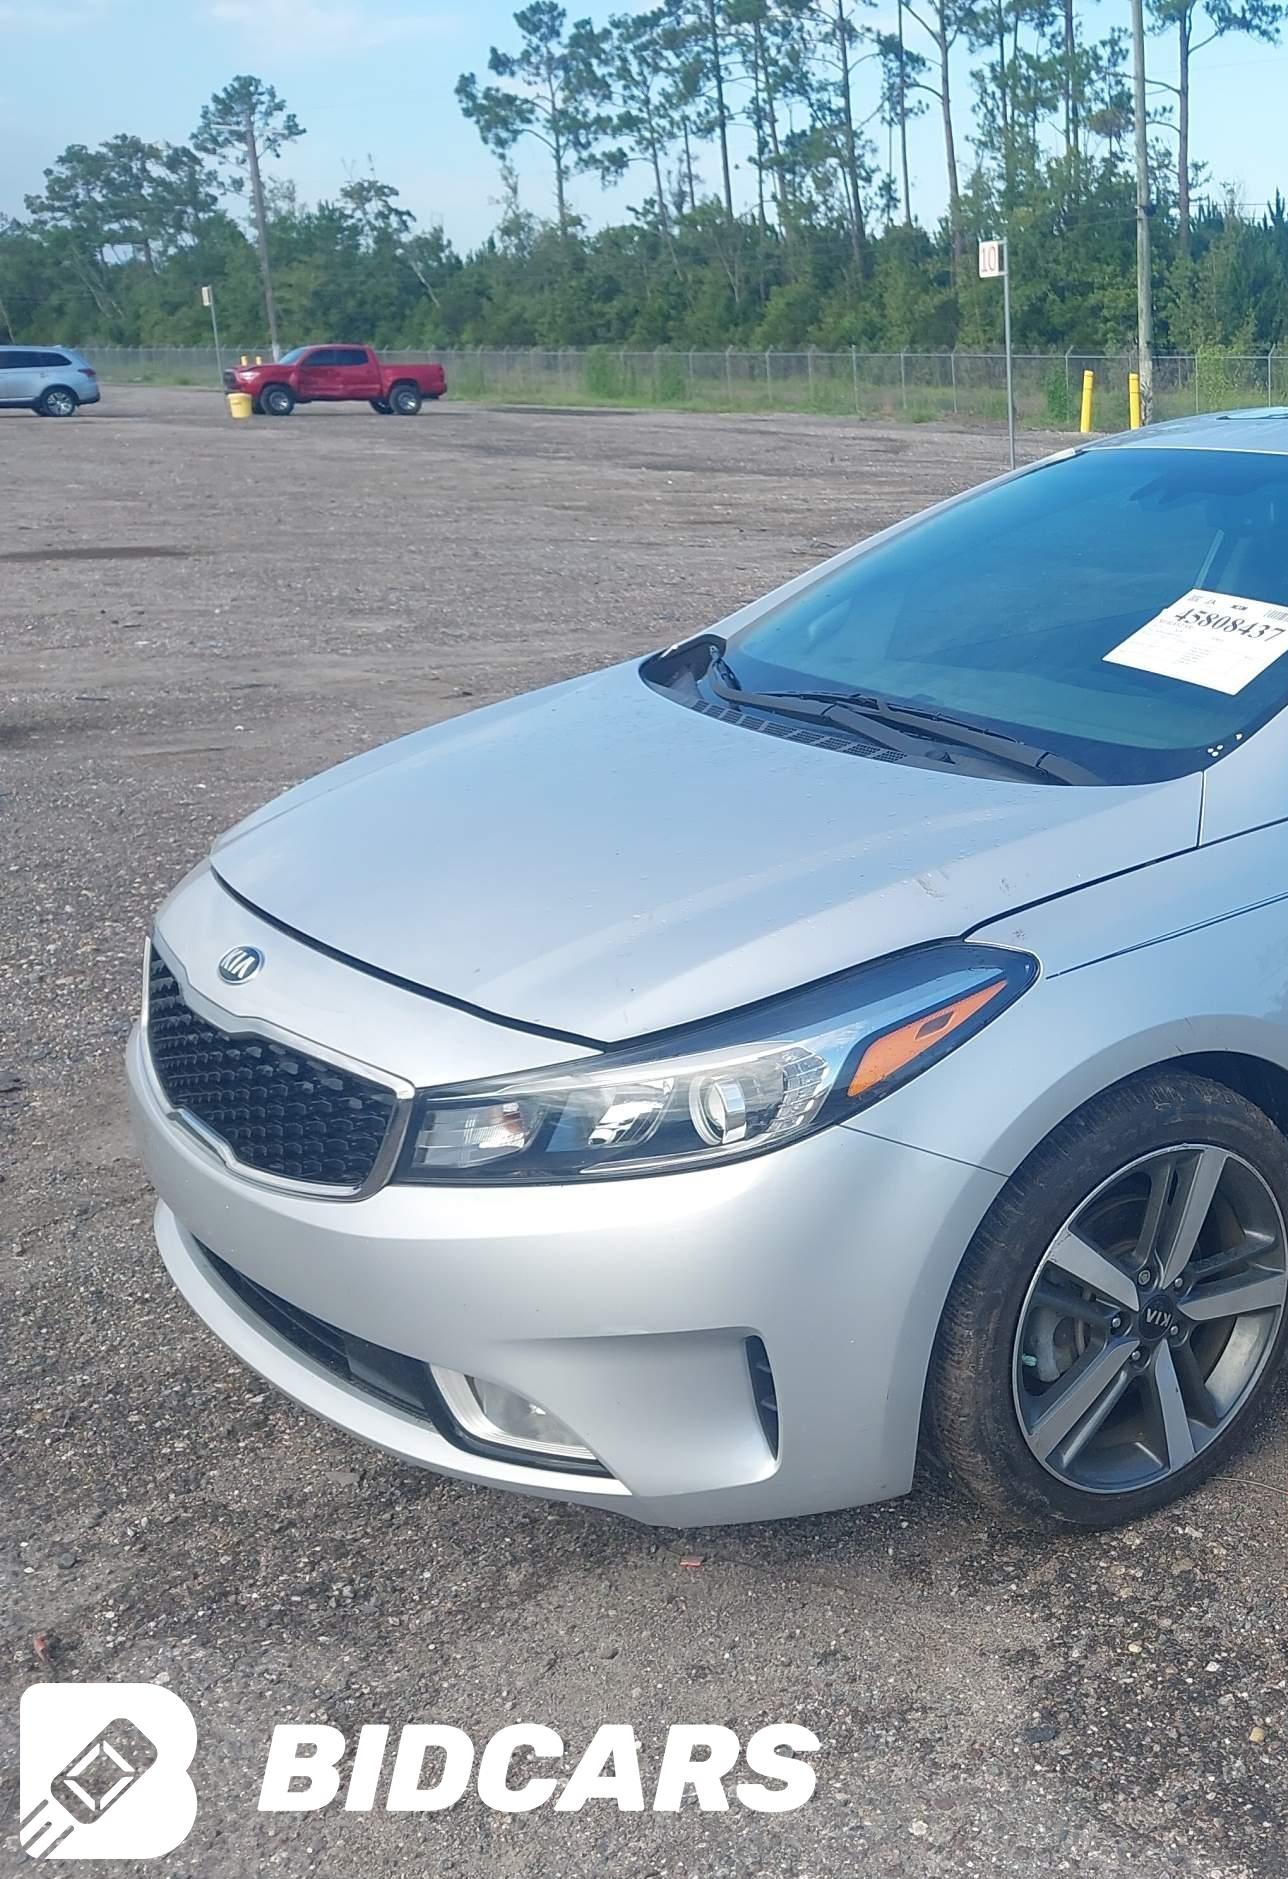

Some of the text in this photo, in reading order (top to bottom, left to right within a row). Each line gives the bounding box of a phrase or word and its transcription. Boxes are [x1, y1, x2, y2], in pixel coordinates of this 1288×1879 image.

[982, 246, 996, 272] 10
[1175, 607, 1286, 642] 45808437
[221, 949, 256, 979] KIA
[1146, 1307, 1172, 1327] KIA
